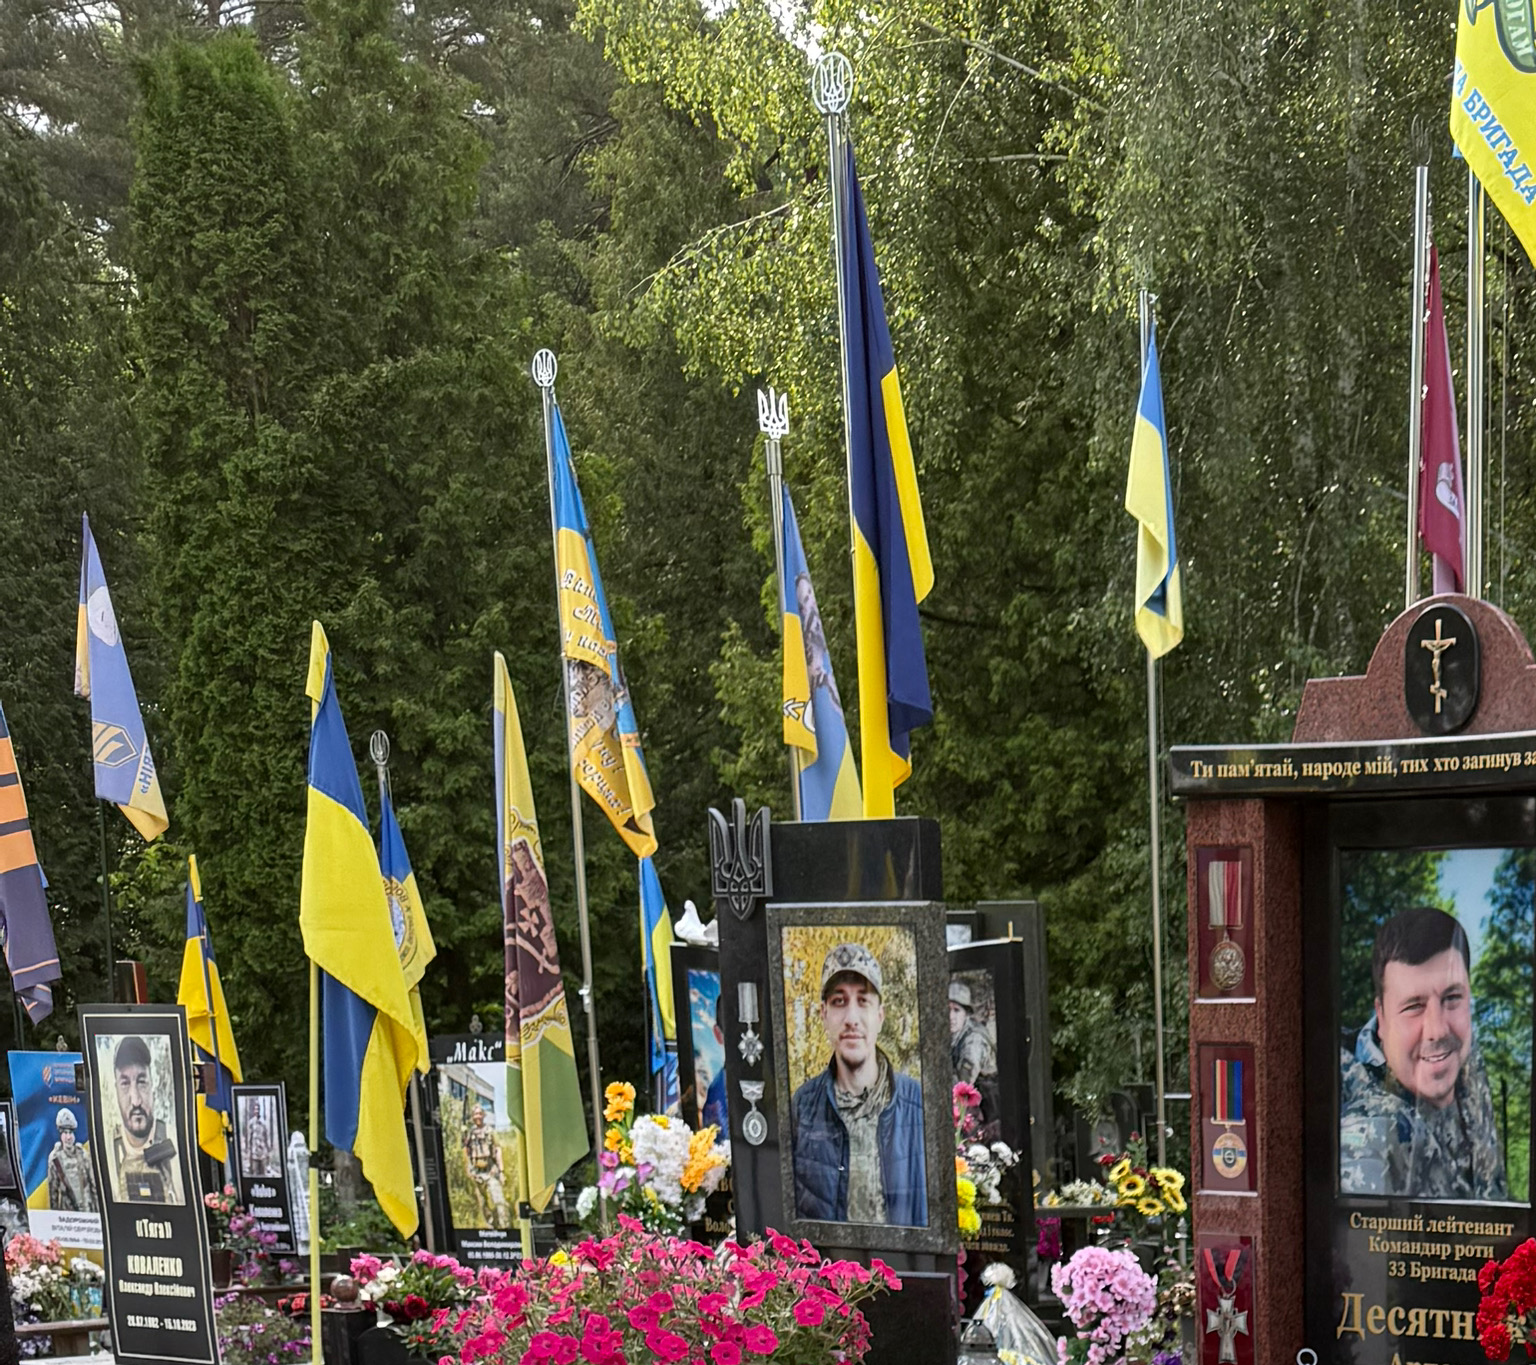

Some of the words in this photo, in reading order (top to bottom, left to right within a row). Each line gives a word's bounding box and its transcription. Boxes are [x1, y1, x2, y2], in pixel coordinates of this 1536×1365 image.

[1190, 760, 1213, 778] Ти
[1302, 760, 1361, 780] народе
[1364, 755, 1398, 777] мій,
[1400, 759, 1429, 774] тих
[1433, 756, 1459, 772] хто
[1462, 751, 1522, 772] загинув
[1350, 1211, 1423, 1234] Старший
[1426, 1215, 1514, 1237] лейтенант
[1368, 1235, 1451, 1259] Командир
[1454, 1244, 1494, 1261] роти
[127, 1254, 183, 1277] КОВАЛЕНКО
[1388, 1260, 1406, 1278] 33
[1410, 1261, 1477, 1283] Бригада
